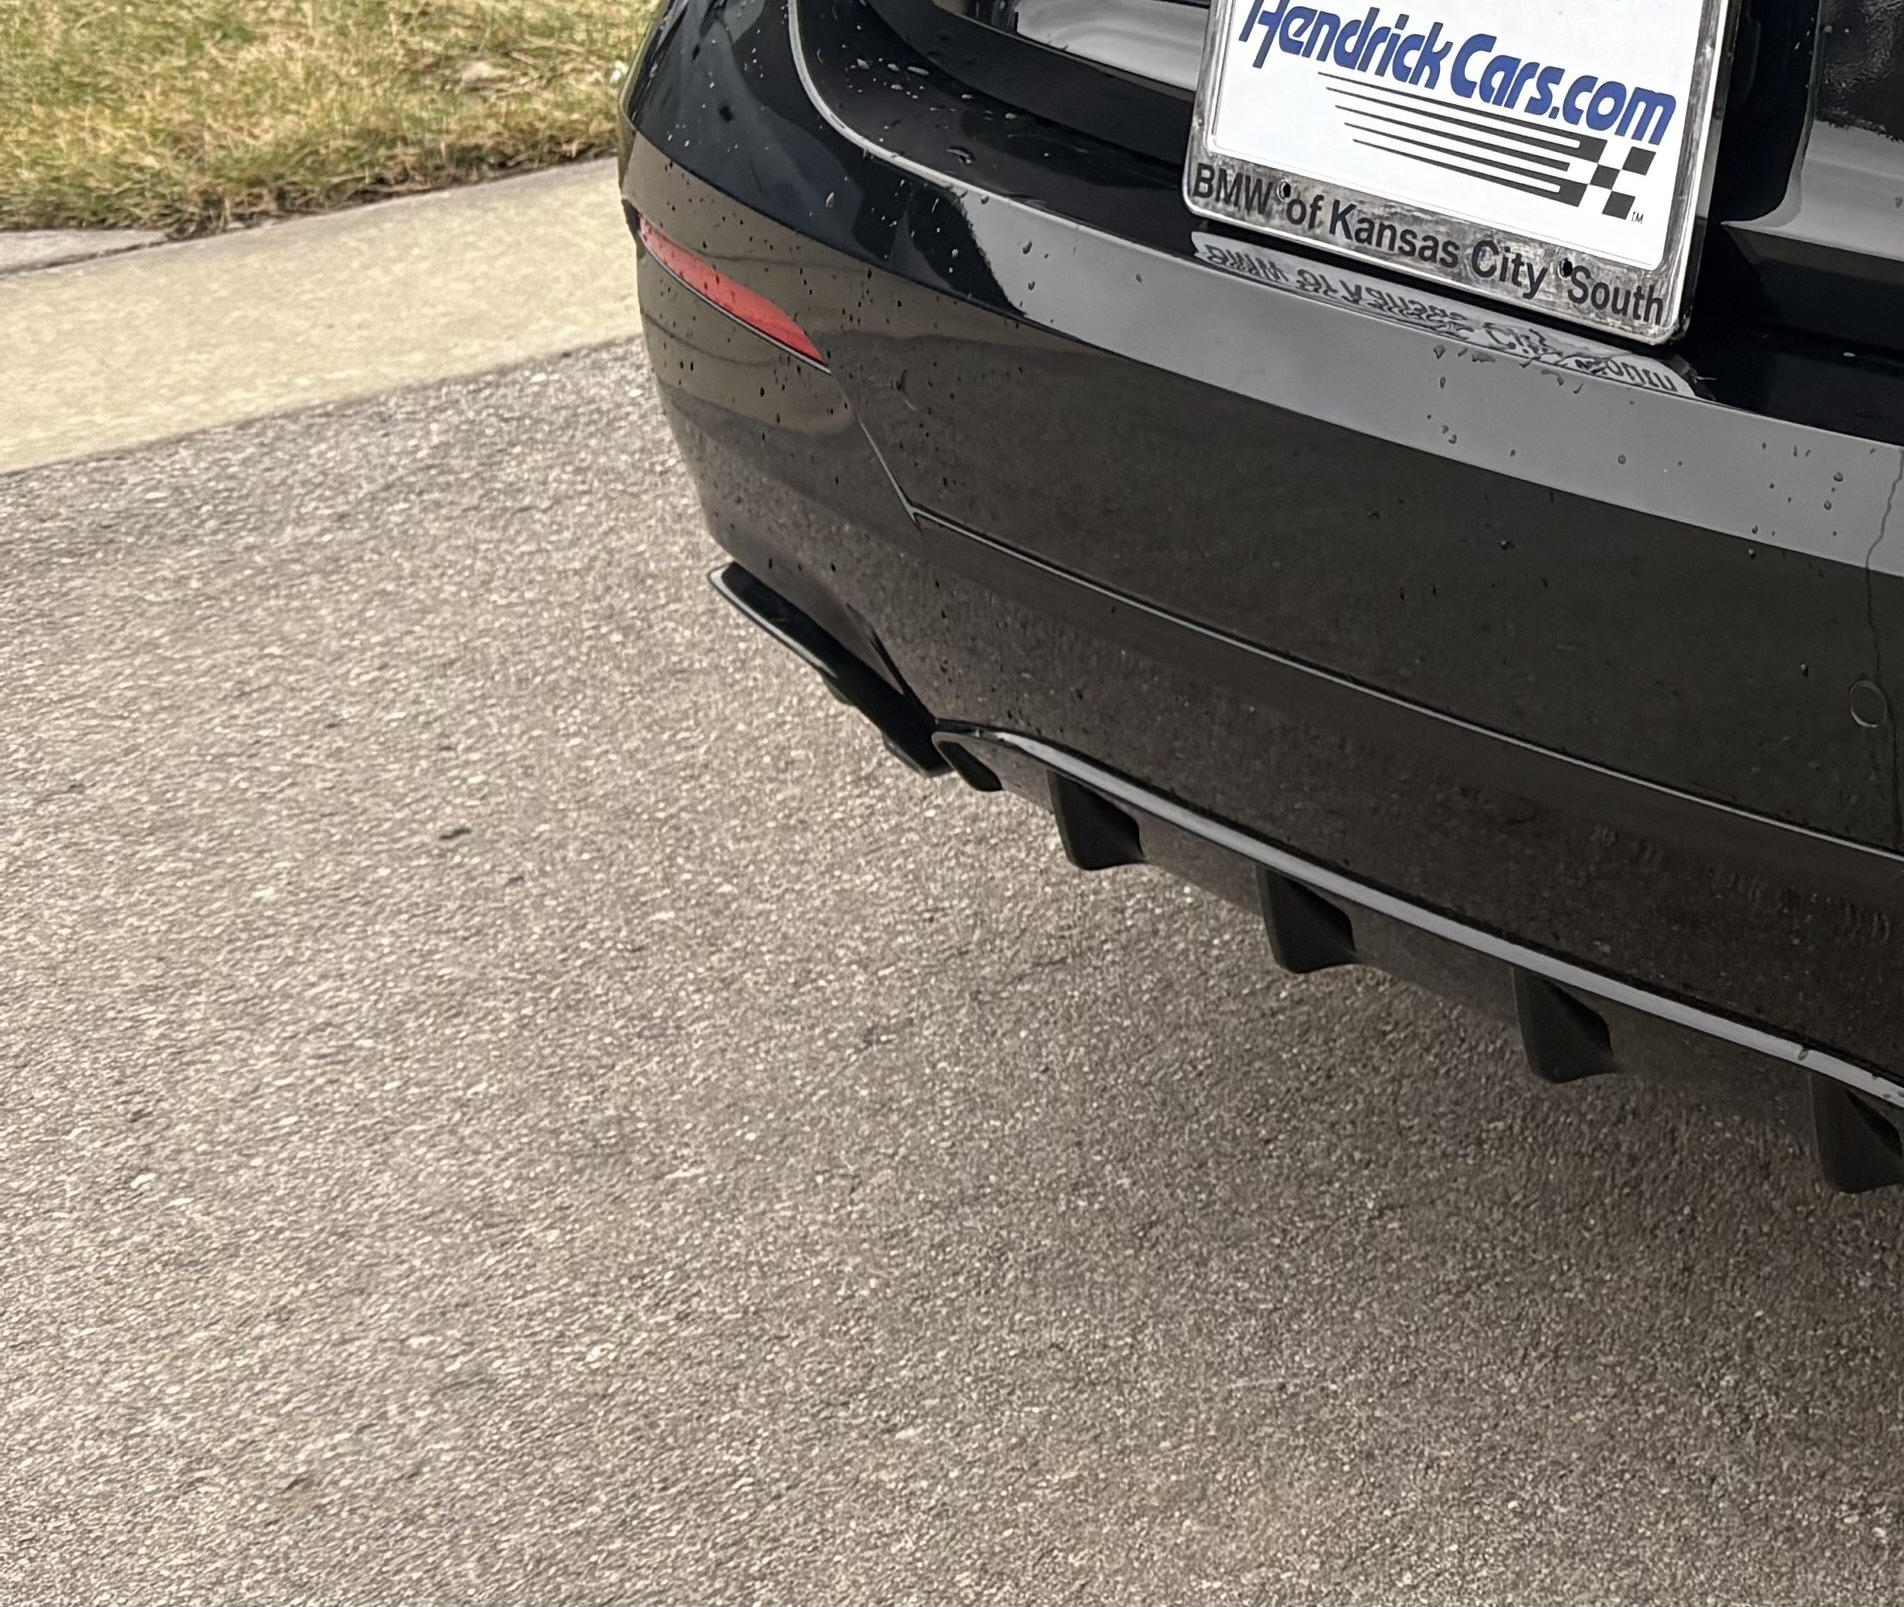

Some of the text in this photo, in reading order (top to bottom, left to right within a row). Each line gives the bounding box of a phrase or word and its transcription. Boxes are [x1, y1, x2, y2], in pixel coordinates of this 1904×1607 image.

[1193, 162, 1274, 215] BMW
[1285, 194, 1324, 230] of
[1328, 198, 1461, 269] Kansas
[1471, 239, 1548, 300] City
[1567, 265, 1664, 326] South
